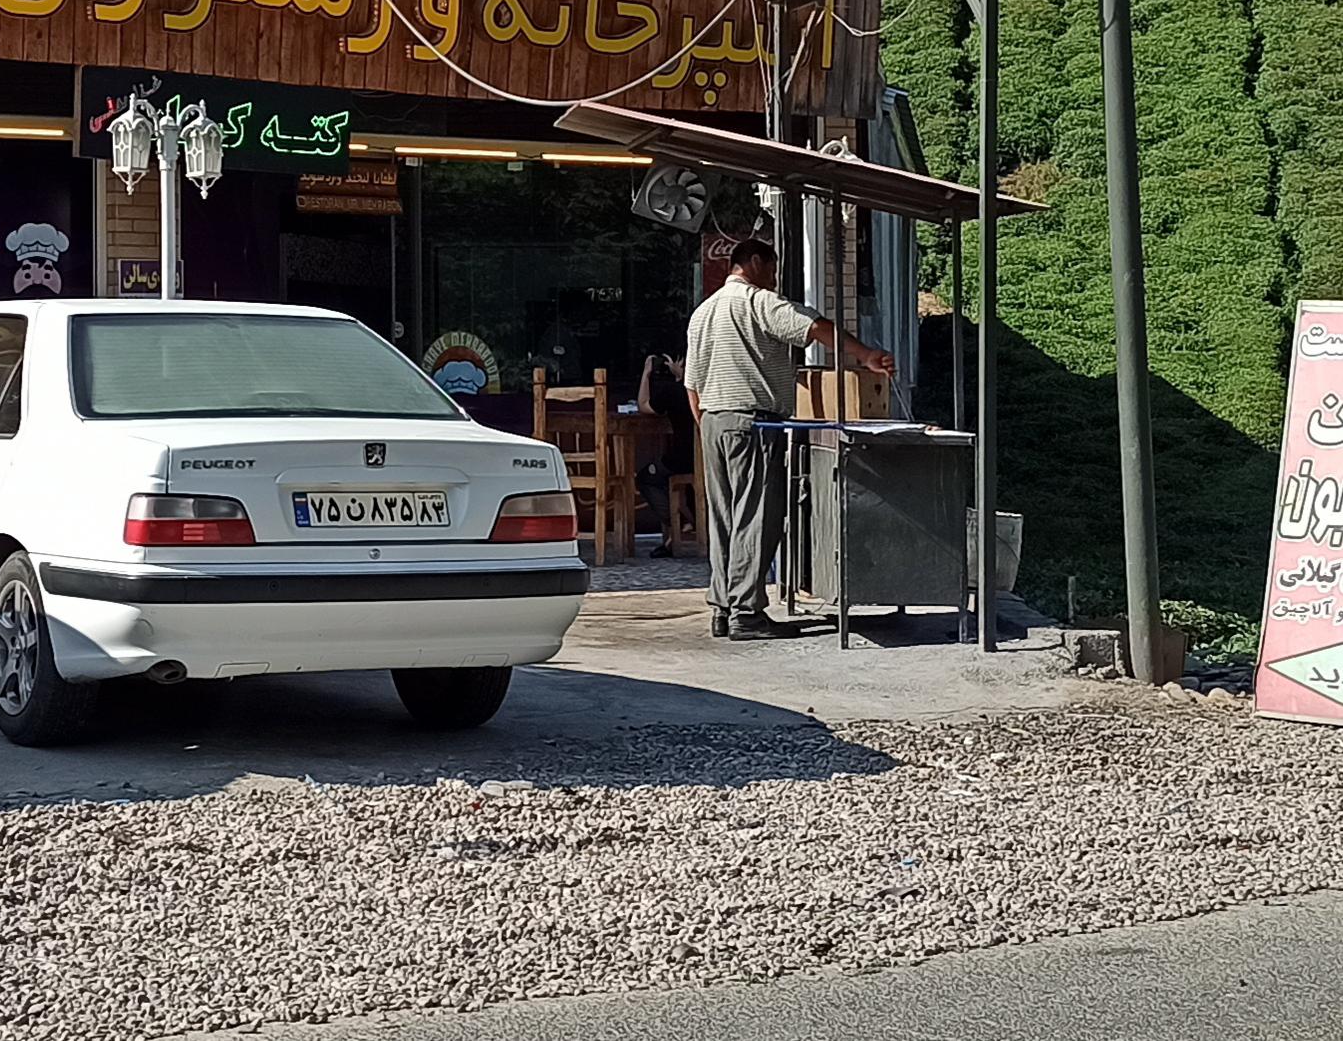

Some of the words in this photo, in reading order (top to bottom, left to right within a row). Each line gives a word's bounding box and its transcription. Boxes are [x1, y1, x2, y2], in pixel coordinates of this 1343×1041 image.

[181, 459, 256, 470] PEUGEOT
[512, 458, 547, 469] PARS
[1279, 559, 1341, 588] گیلانی
[1272, 598, 1334, 621] آلاچیق
